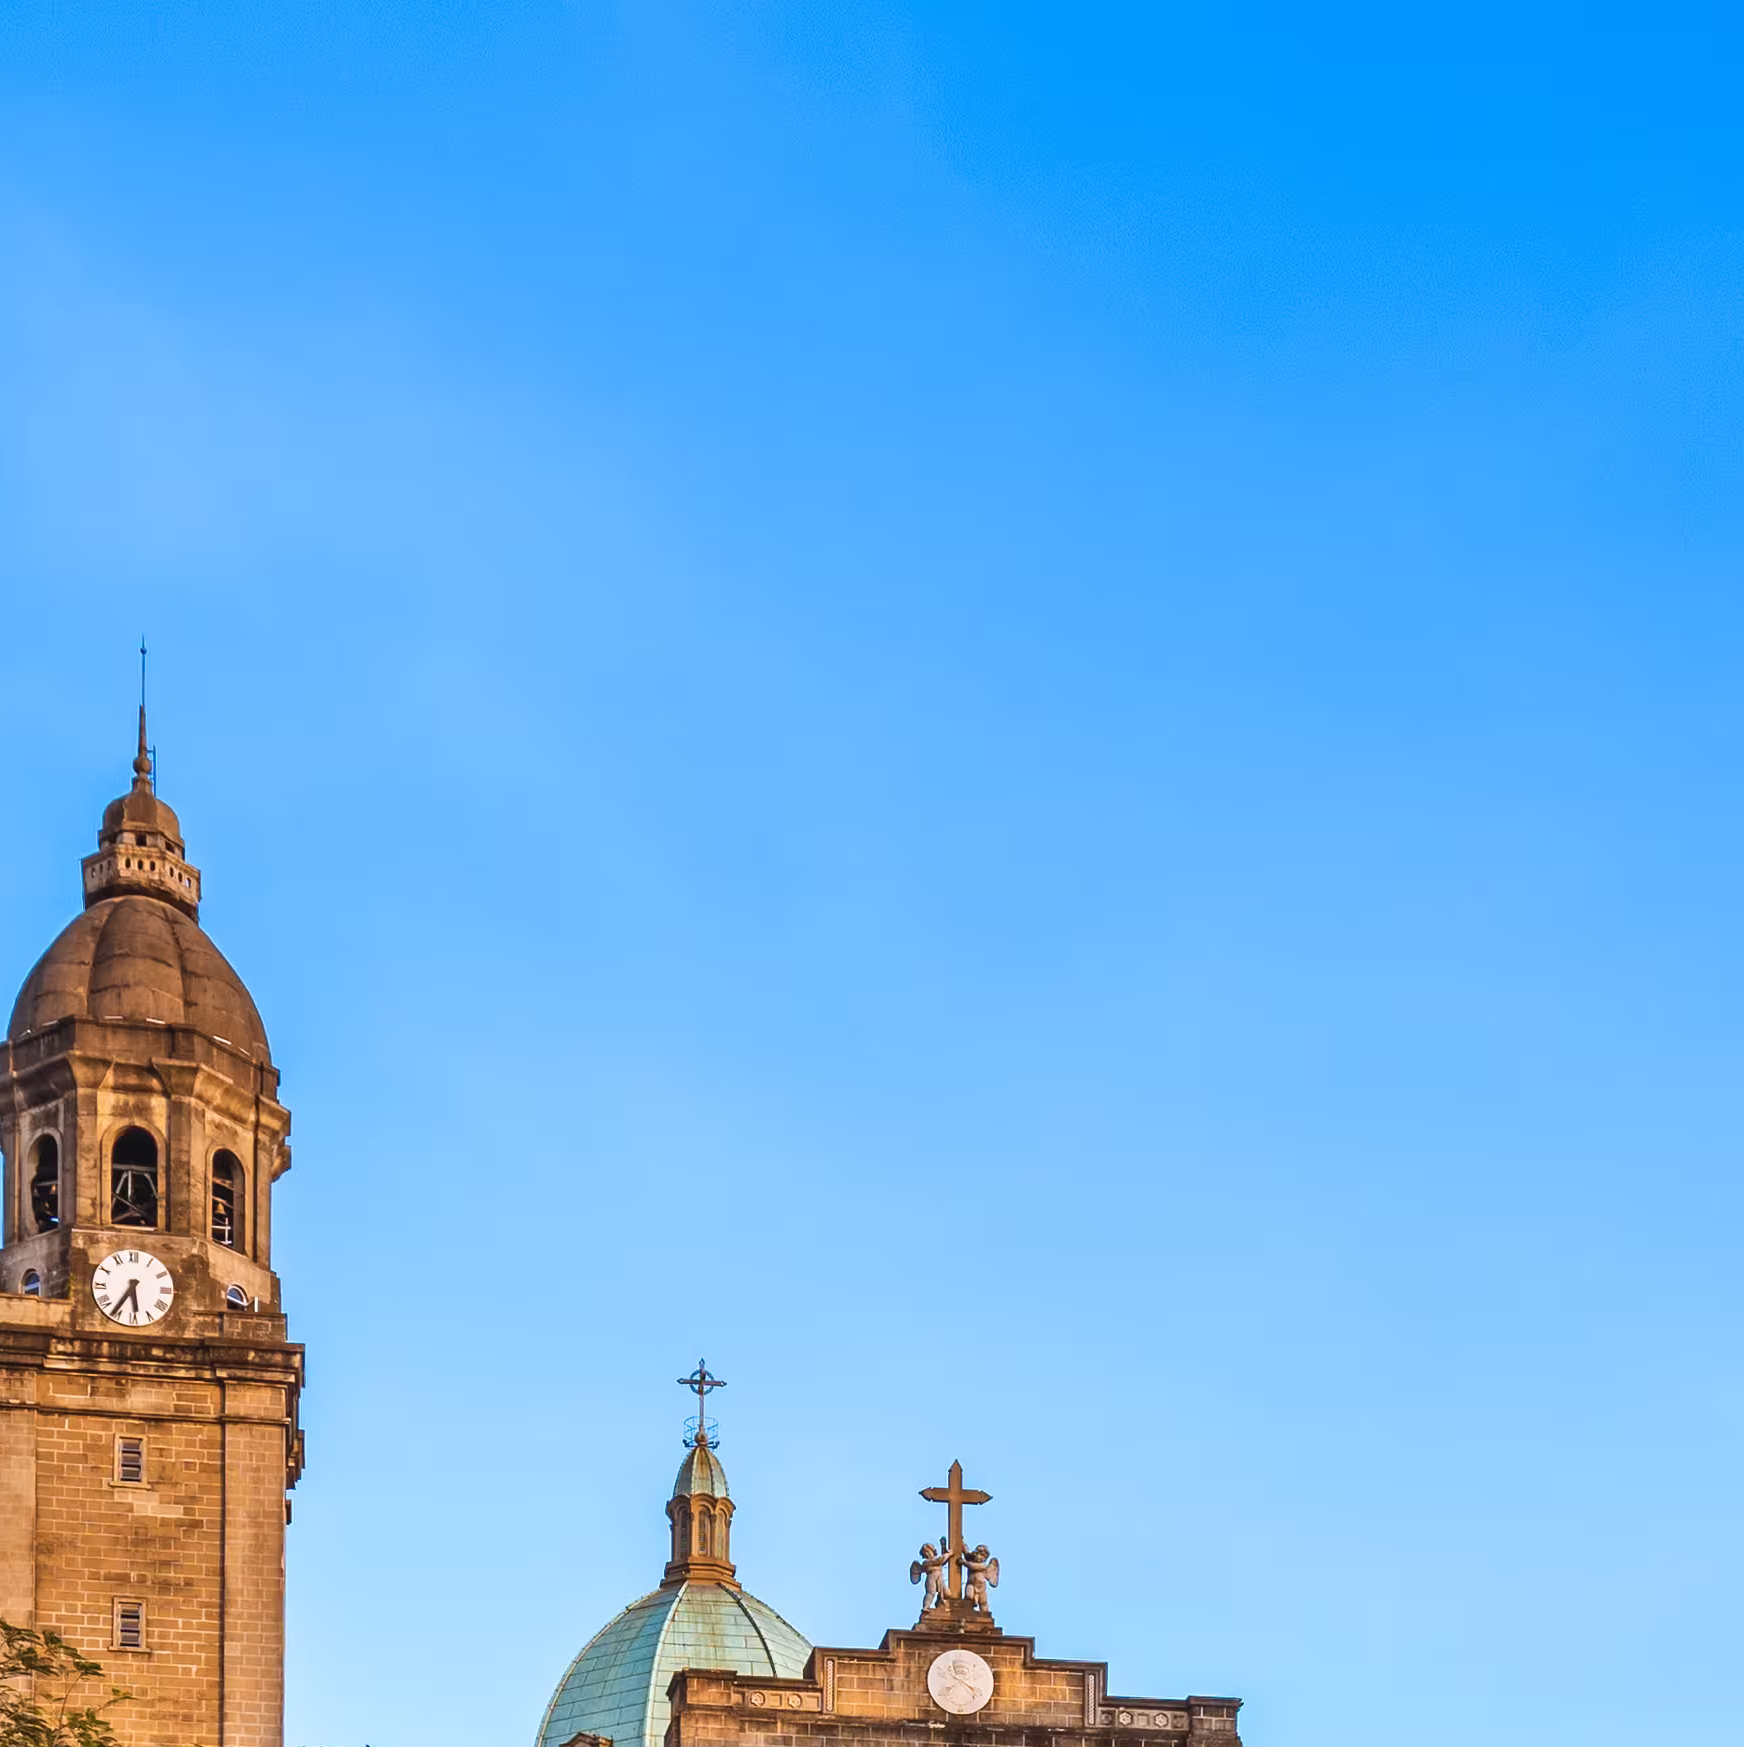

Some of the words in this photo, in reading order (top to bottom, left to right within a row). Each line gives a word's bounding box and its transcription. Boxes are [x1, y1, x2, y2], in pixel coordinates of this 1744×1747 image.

[112, 1253, 124, 1266] XI
[129, 1251, 139, 1263] XII
[99, 1266, 110, 1275] X
[95, 1282, 107, 1290] IX
[146, 1311, 154, 1321] V
